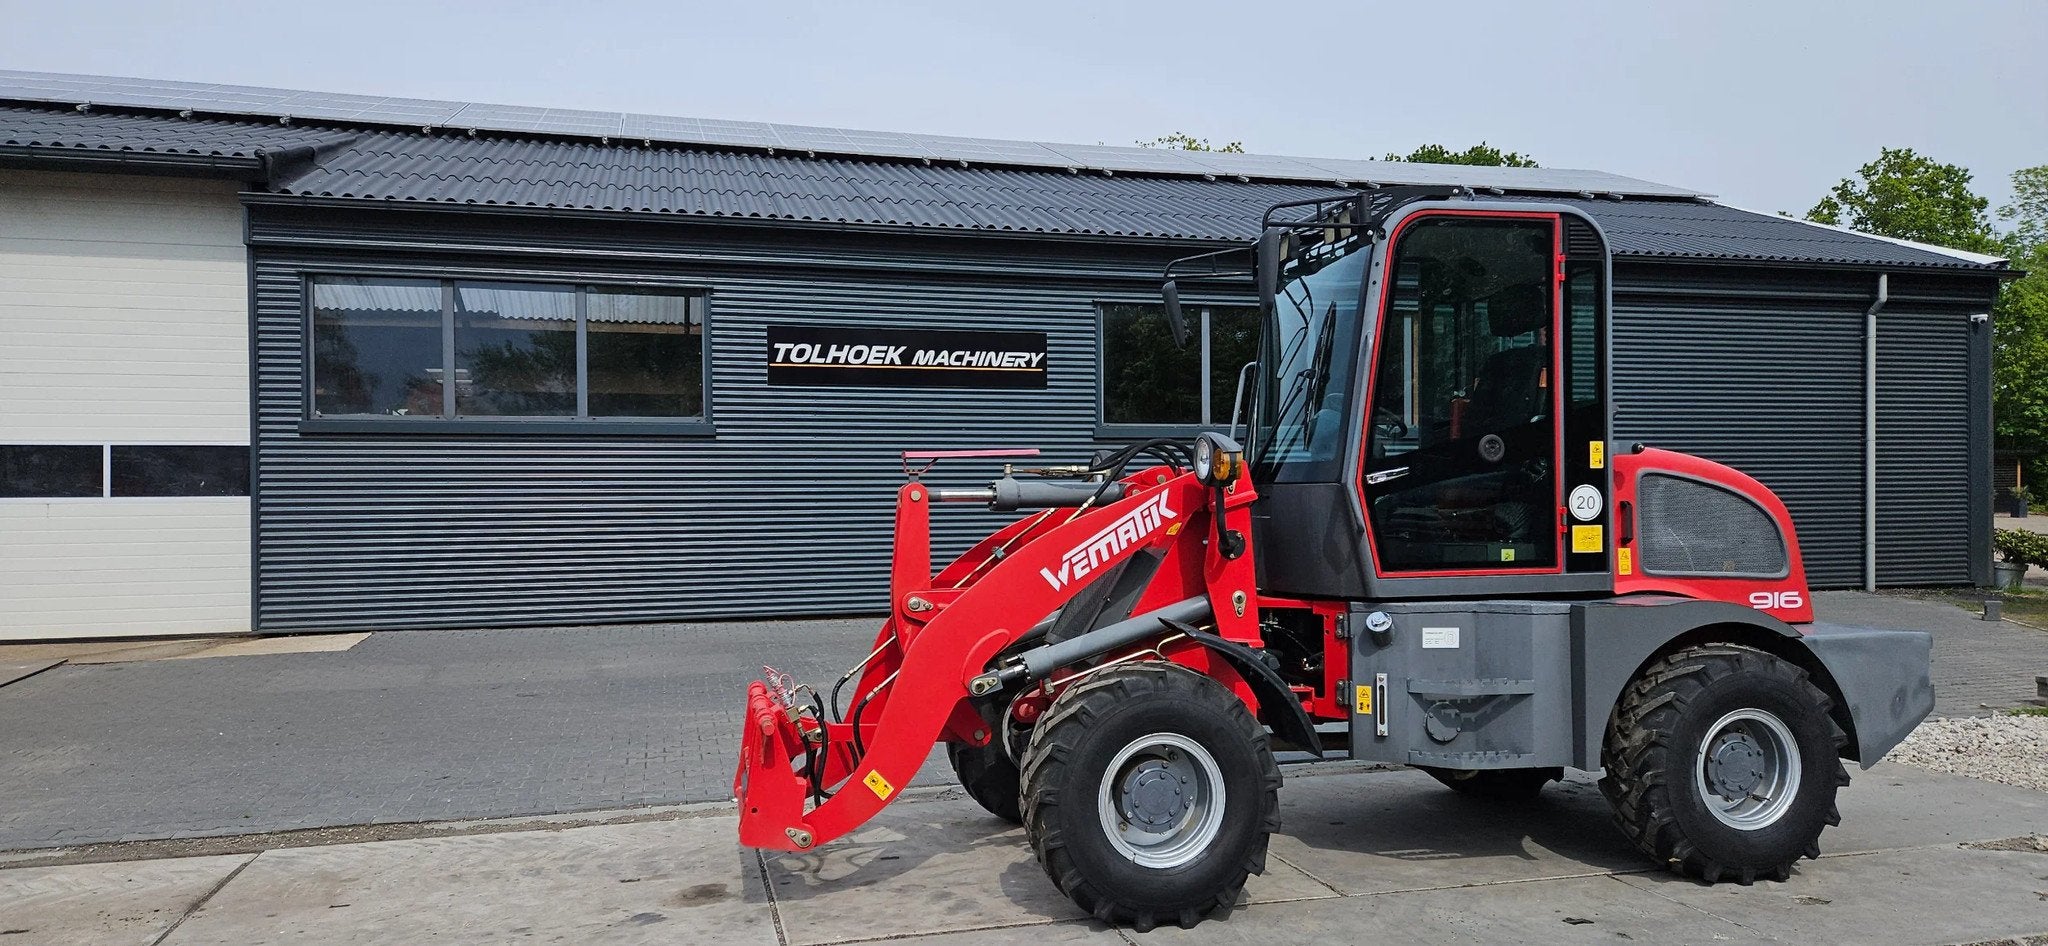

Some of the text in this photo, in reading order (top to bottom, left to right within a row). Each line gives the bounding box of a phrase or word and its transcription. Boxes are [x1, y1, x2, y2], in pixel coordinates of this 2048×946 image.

[773, 343, 1045, 368] TOLHOEK MACHINERY
[1576, 495, 1596, 510] 20
[1749, 591, 1803, 609] 916
